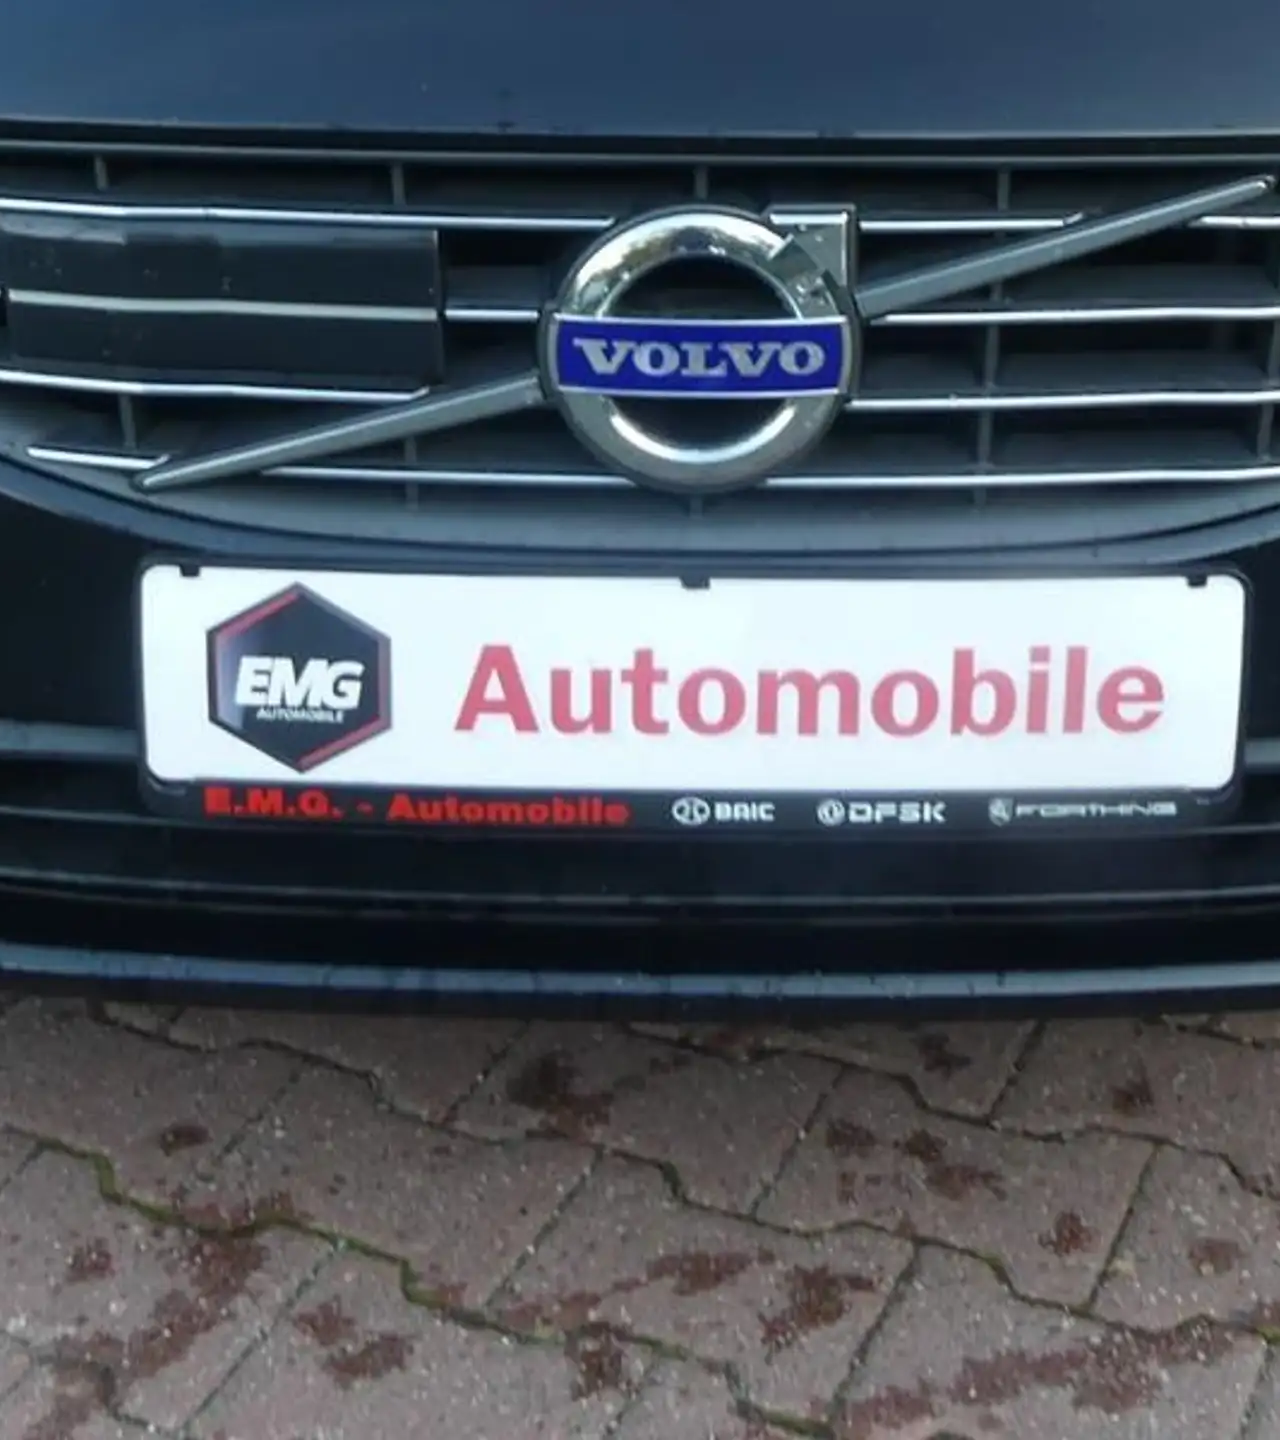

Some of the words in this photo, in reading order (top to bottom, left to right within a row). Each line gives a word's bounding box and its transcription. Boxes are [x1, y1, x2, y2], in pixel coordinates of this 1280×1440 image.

[573, 337, 826, 378] VOLVO
[235, 655, 365, 710] EMG
[454, 644, 1165, 738] Automobile
[204, 786, 344, 820] E.M.G.
[387, 793, 631, 826] Automobile
[848, 801, 947, 825] DFSK
